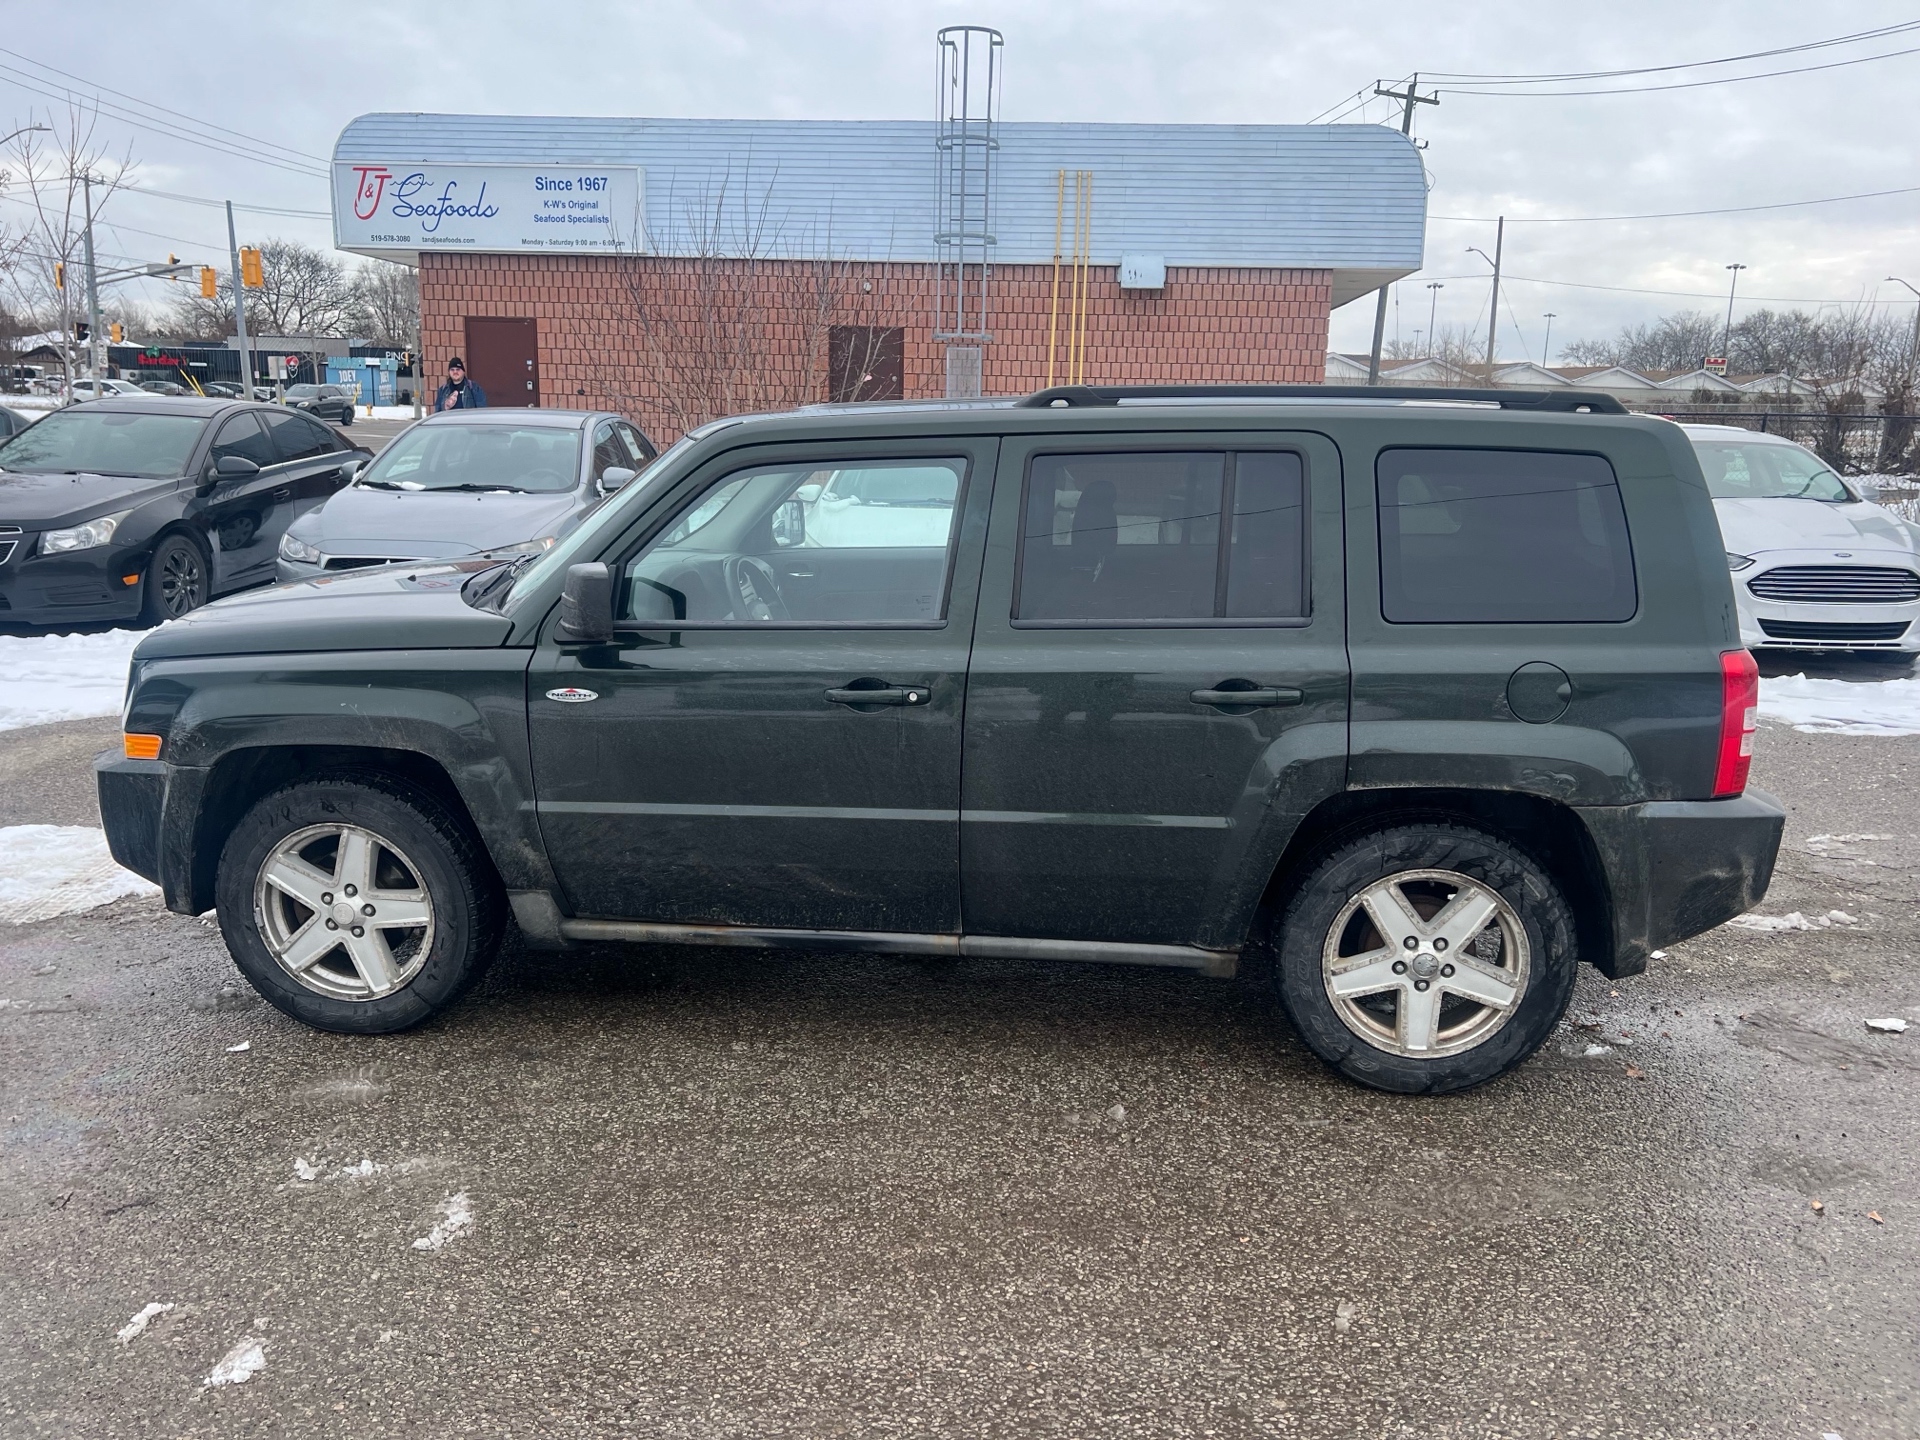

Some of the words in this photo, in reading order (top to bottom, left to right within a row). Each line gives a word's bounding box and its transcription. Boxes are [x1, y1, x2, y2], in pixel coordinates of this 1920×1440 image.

[535, 176, 573, 191] Since
[577, 177, 608, 191] 1967
[390, 173, 499, 232] Seafoods
[543, 200, 566, 209] K-W's
[568, 200, 599, 211] Original
[533, 214, 566, 223] Seafood
[567, 214, 610, 225] Specialists
[370, 234, 411, 243] 519-578-3080
[421, 235, 476, 244] tandjseafoods.com
[521, 238, 544, 246] Monday
[548, 239, 574, 247] Saturday
